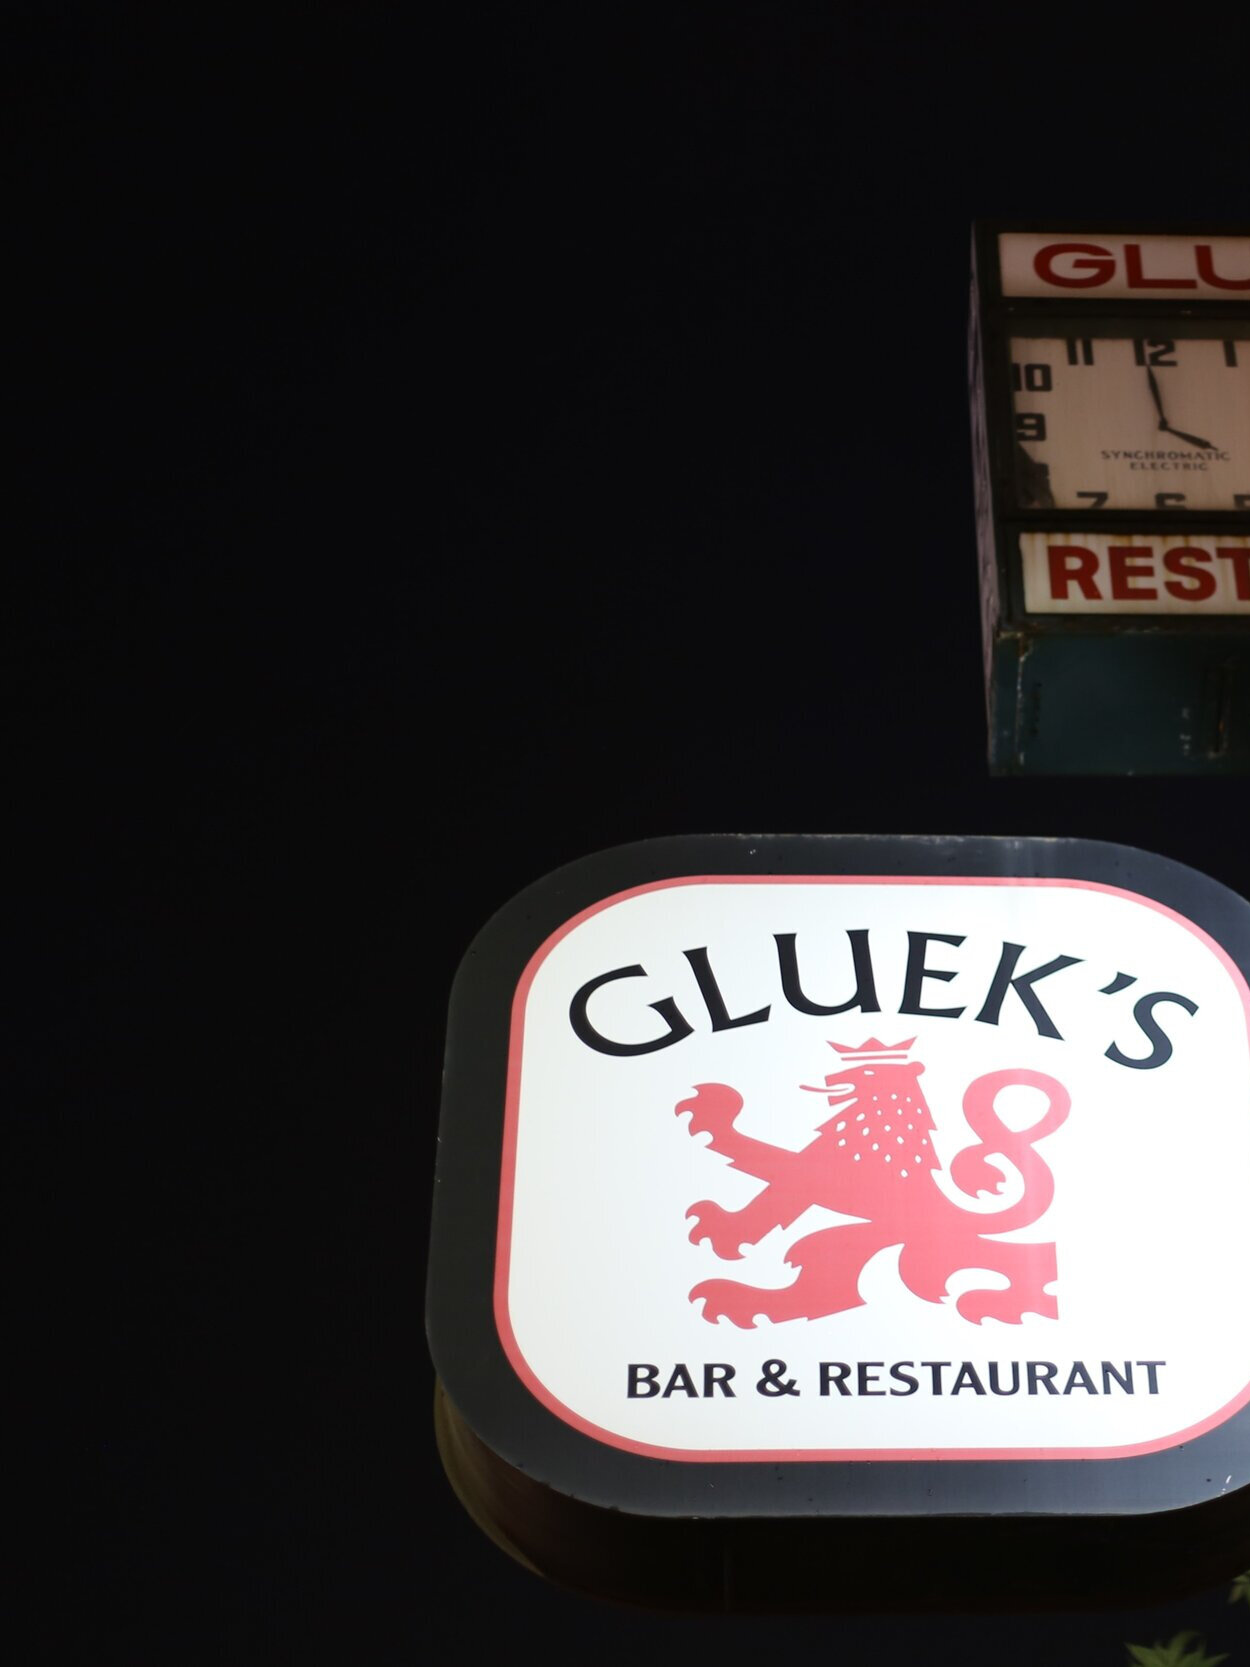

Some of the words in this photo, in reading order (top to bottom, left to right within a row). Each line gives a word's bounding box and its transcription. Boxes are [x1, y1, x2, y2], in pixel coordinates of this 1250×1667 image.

[1066, 338, 1094, 366] 11
[1134, 339, 1177, 367] 12
[1222, 339, 1237, 367] 1
[1011, 364, 1052, 391] 10
[1015, 413, 1046, 441] 9
[1101, 450, 1231, 462] SYNCHROMATIC
[1129, 462, 1208, 471] ELECTRIC
[569, 929, 1200, 1070] GLUEK'S
[626, 1362, 737, 1400] BAR
[755, 1358, 801, 1398] &
[818, 1360, 1167, 1397] RESTAURANT
